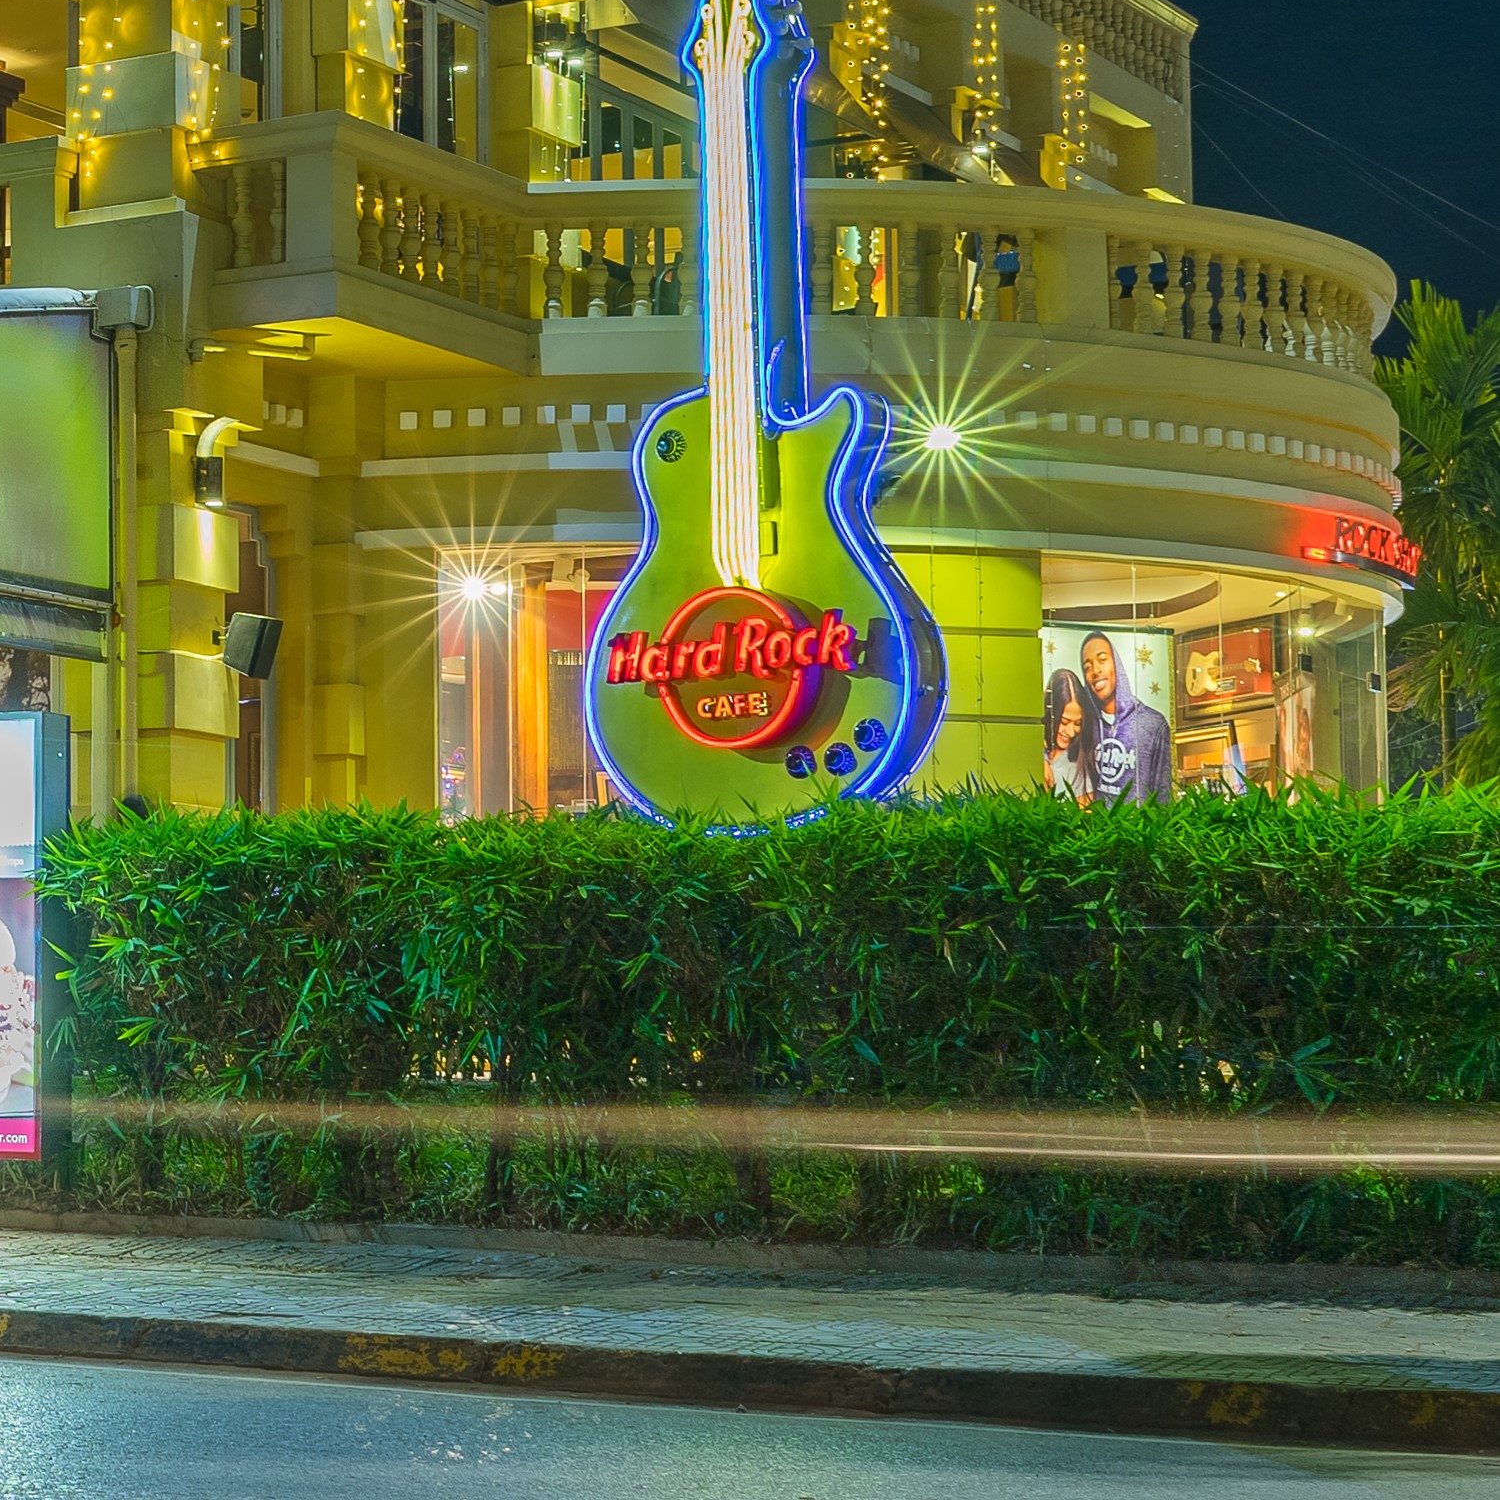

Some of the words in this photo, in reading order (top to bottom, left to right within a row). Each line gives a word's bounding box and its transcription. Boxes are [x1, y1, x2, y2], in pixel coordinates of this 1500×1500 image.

[1335, 516, 1391, 562] ROCK
[607, 621, 728, 684] Hard
[732, 608, 855, 679] Rock
[696, 691, 768, 718] CAFE
